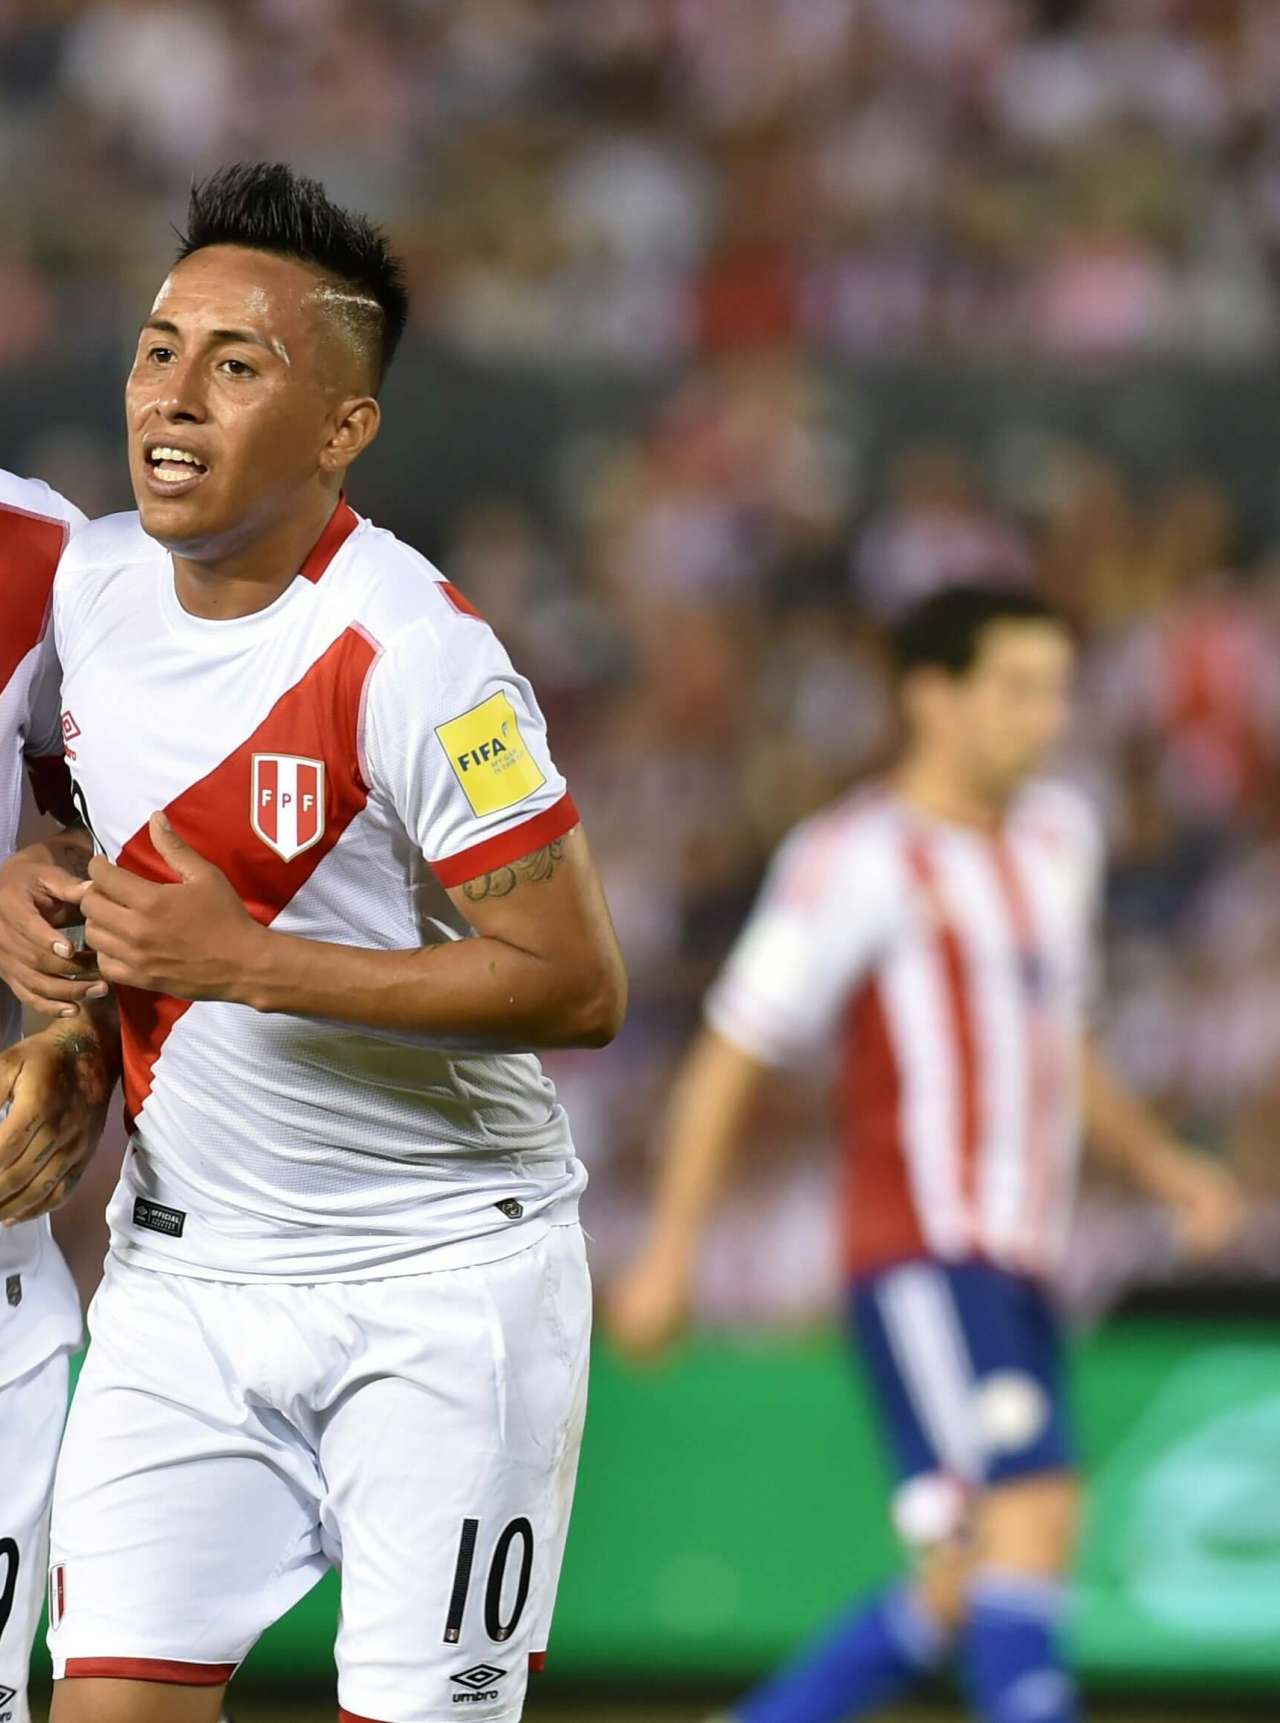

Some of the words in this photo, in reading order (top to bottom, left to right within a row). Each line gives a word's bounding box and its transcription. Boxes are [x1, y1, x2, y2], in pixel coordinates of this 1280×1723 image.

[457, 737, 507, 772] FIFA
[442, 1516, 534, 1644] 10
[452, 1689, 499, 1703] umbro
